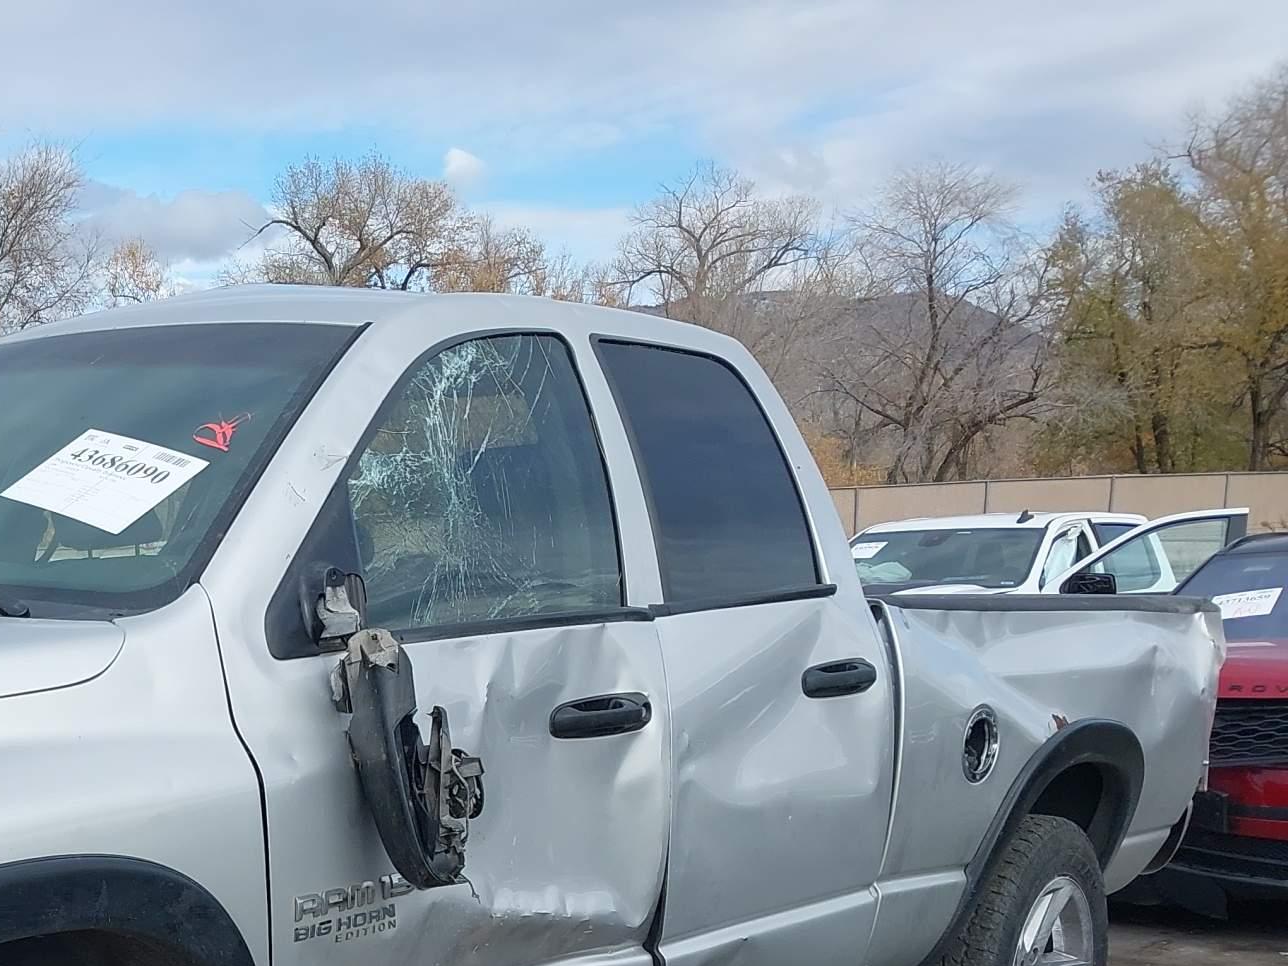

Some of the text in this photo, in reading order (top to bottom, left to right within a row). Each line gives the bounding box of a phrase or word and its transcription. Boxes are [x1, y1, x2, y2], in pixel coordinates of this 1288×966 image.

[70, 447, 171, 485] 43686090
[294, 881, 376, 923] RAM
[293, 903, 396, 943] BIG HORN
[335, 919, 397, 943] EDITION
